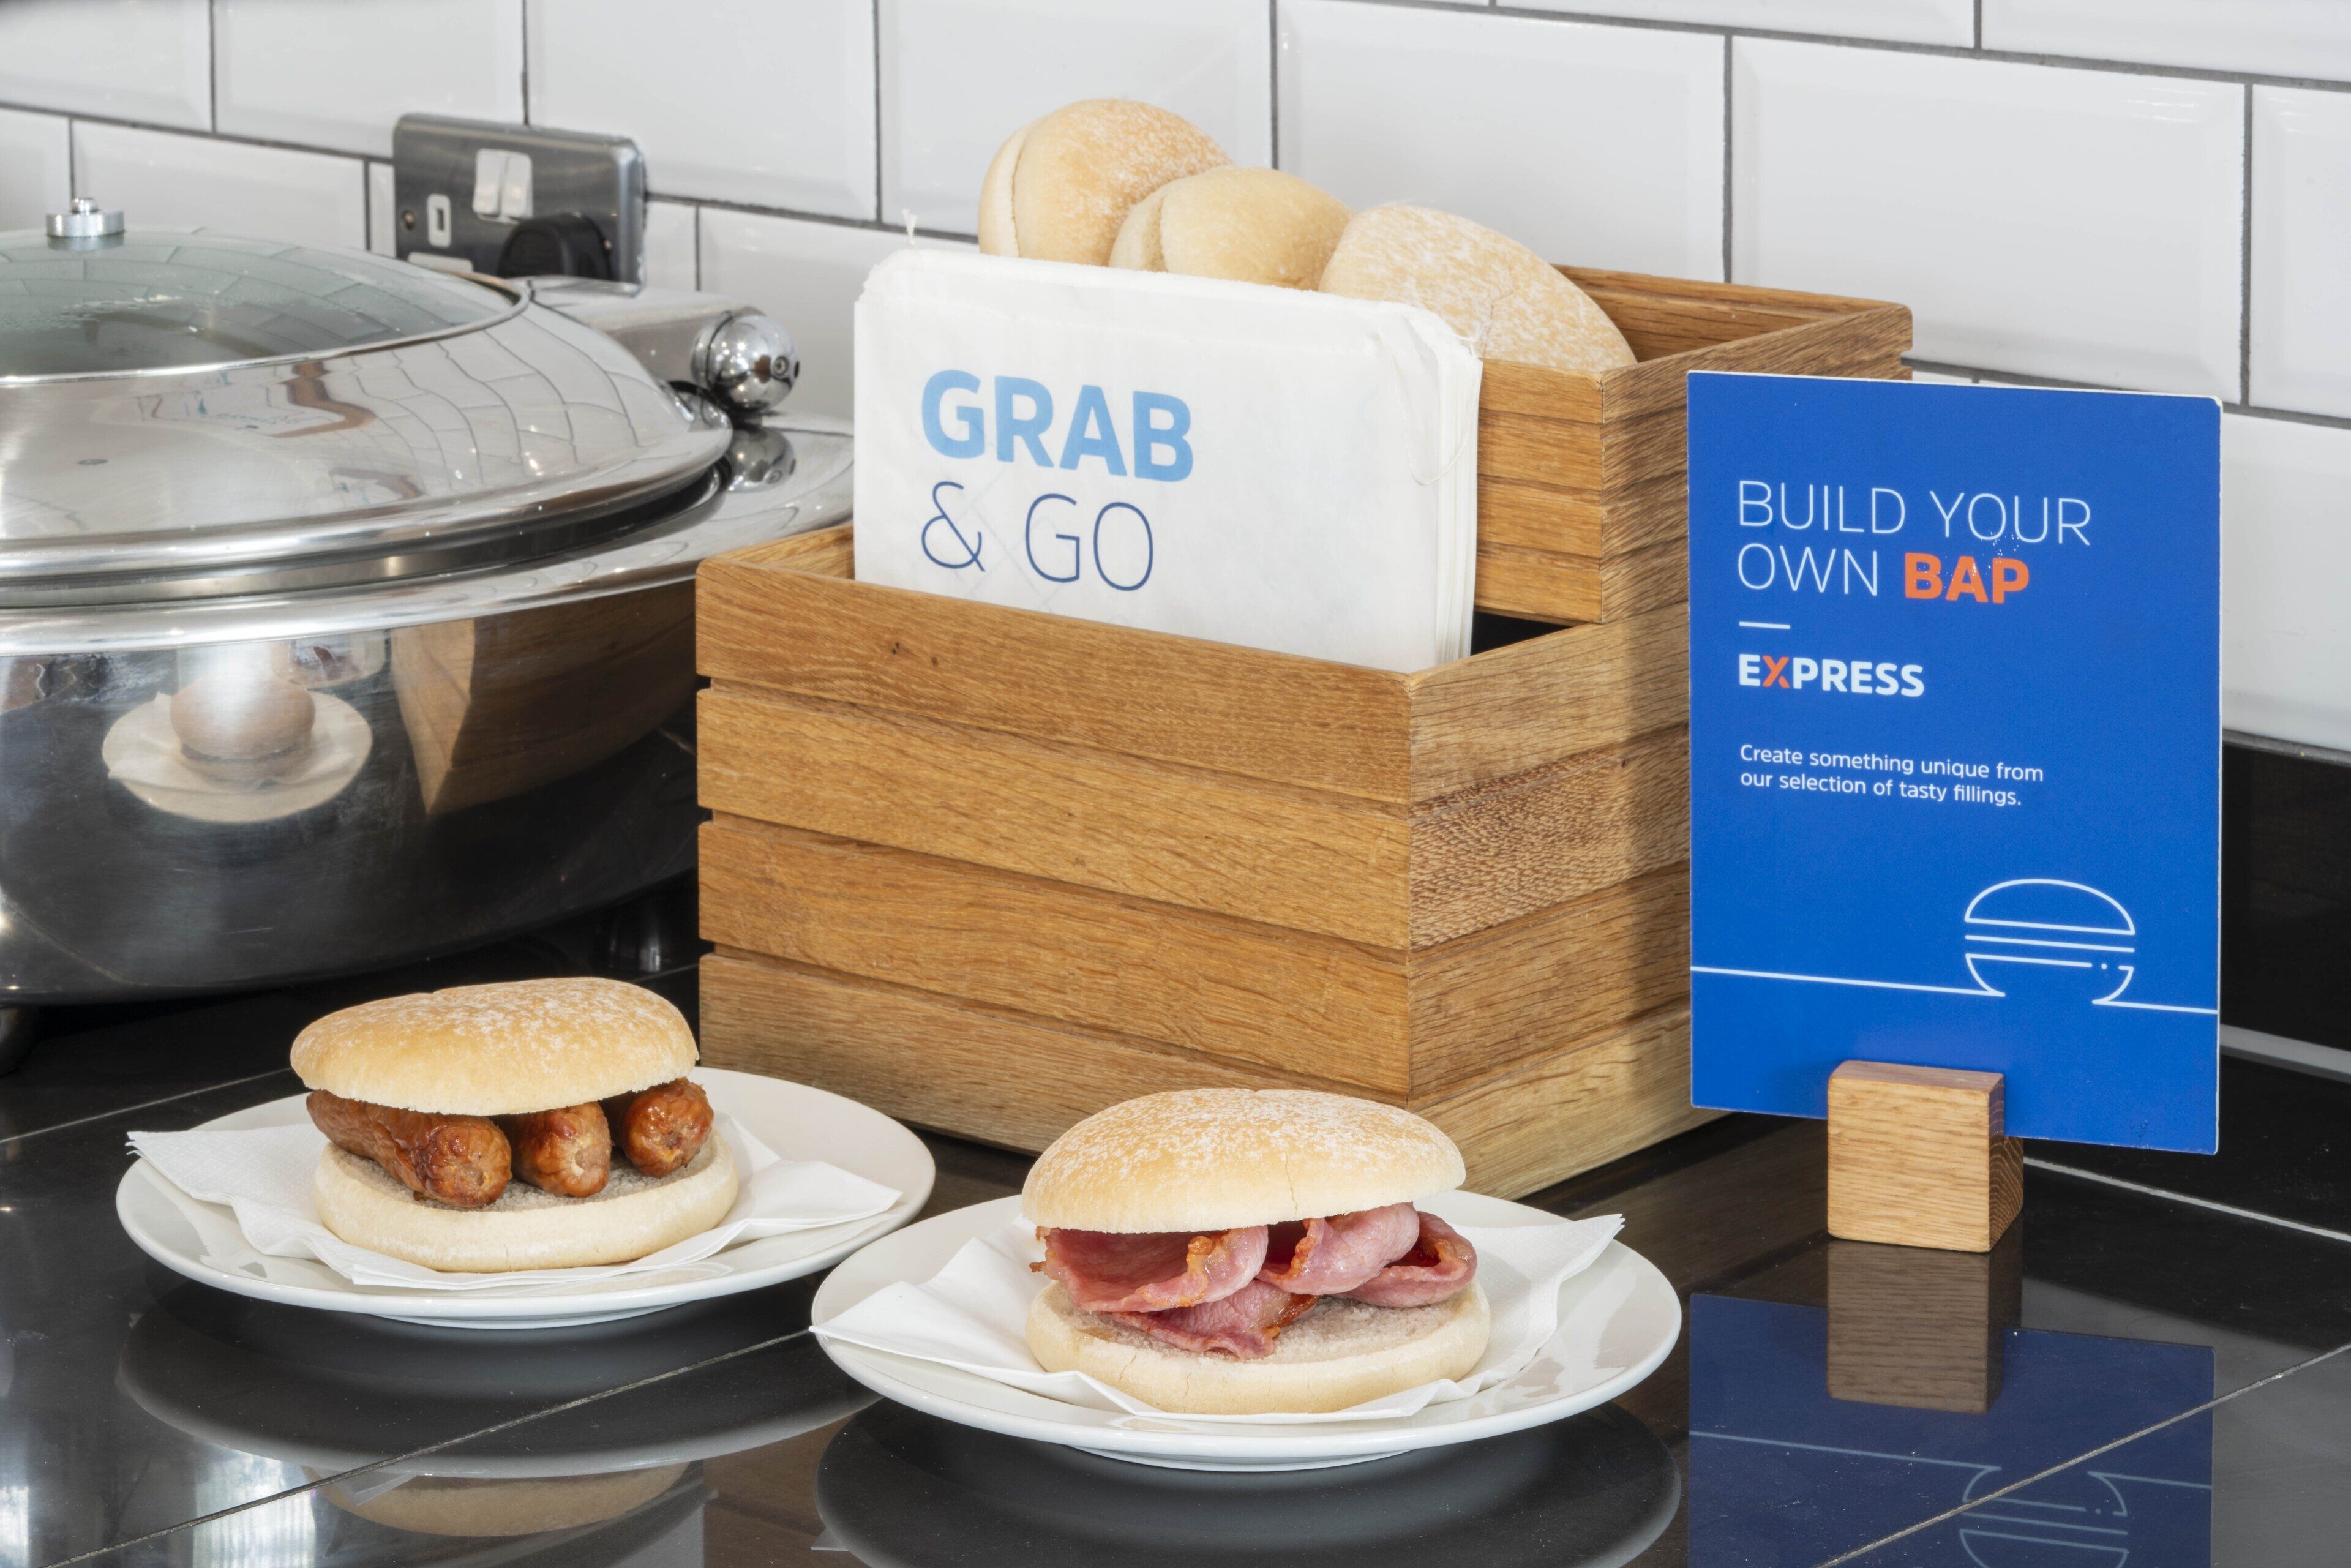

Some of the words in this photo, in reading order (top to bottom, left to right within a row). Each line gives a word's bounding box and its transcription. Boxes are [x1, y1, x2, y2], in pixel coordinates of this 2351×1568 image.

[921, 369, 1194, 482] GRAB
[921, 481, 986, 572] &
[1025, 493, 1153, 592] GO
[1740, 481, 1905, 534] BUILD
[1930, 491, 2091, 546] YOUR
[1738, 543, 1878, 596] OWN
[1903, 552, 2030, 604] BAP
[1739, 653, 1924, 697] EXPRESS
[1740, 772, 1772, 787] our
[1779, 774, 1866, 795] selection
[1873, 779, 1892, 796] of
[1899, 781, 1947, 802] tasty
[1954, 784, 2022, 806] fillings.
[1741, 745, 1802, 765] Create
[1809, 752, 1914, 775] something
[1921, 760, 1990, 779] unique
[1996, 762, 2044, 781] from
